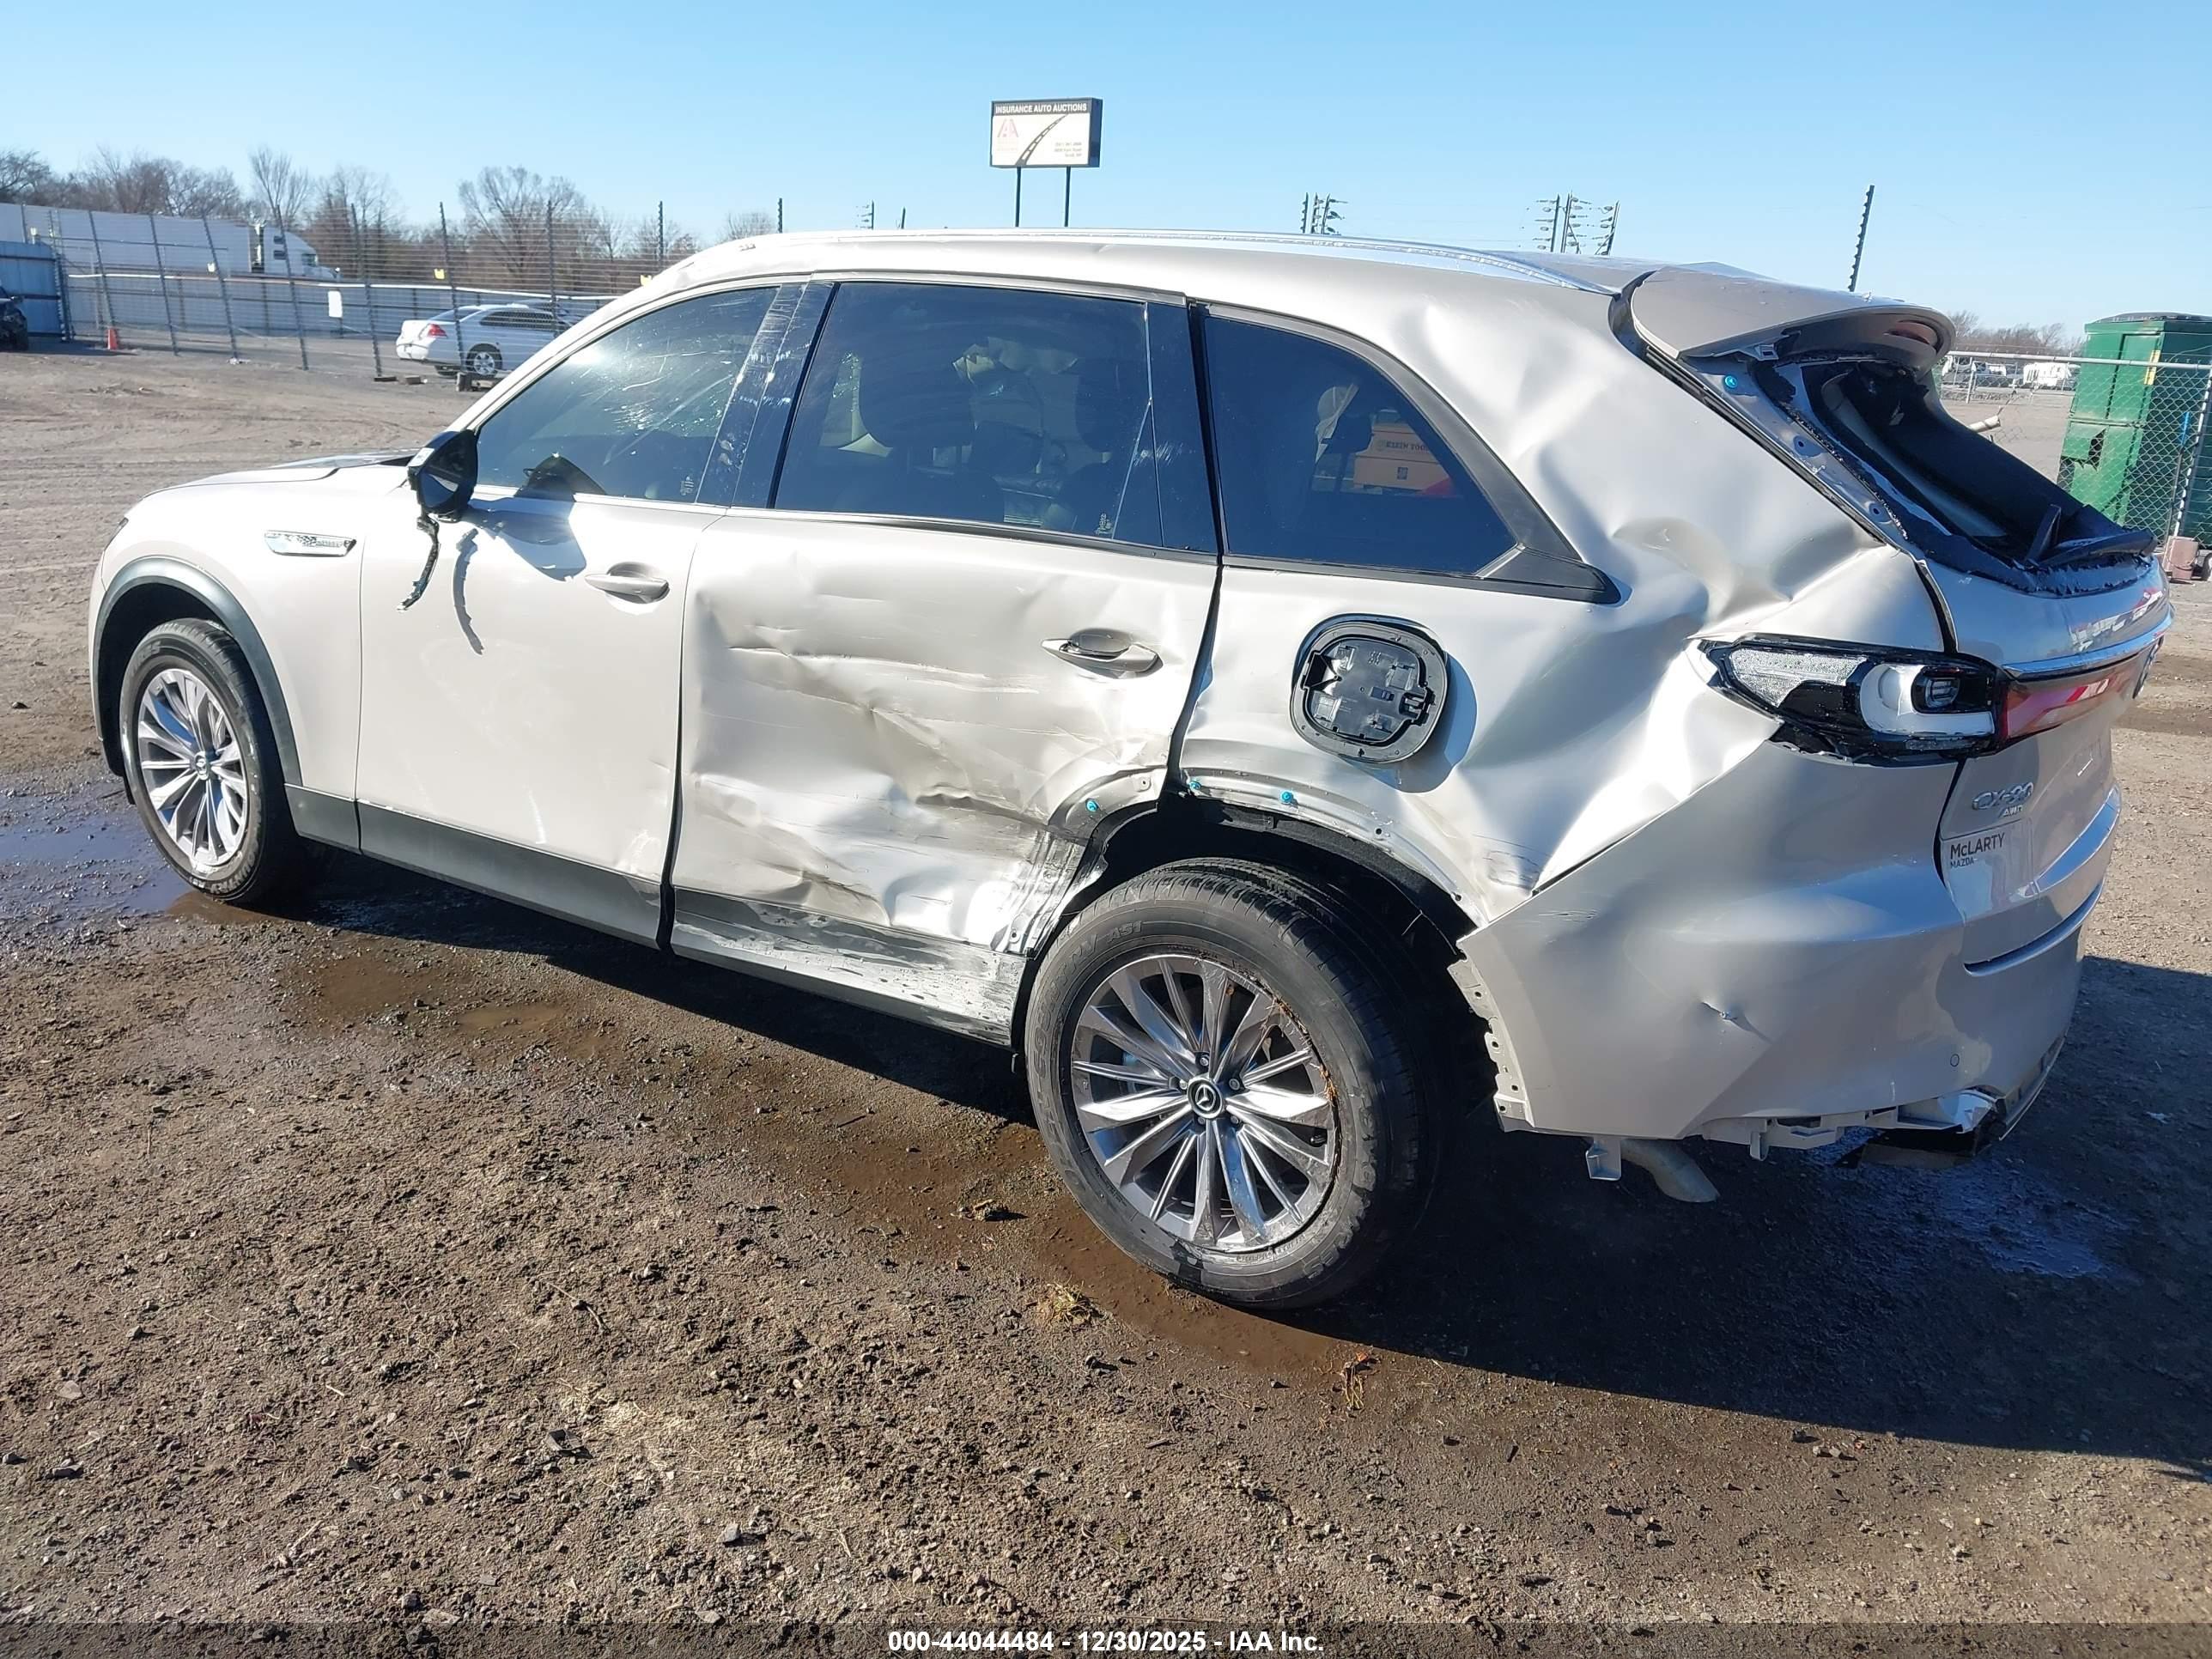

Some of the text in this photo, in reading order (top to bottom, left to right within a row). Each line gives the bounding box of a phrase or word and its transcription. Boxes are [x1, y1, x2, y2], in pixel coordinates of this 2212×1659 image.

[995, 102, 1087, 114] INSURANCE AUTO AUCTIONS
[1972, 781, 2034, 811] CX-90
[1950, 832, 2006, 860] McLARTY
[1949, 857, 1975, 869] MAZDA
